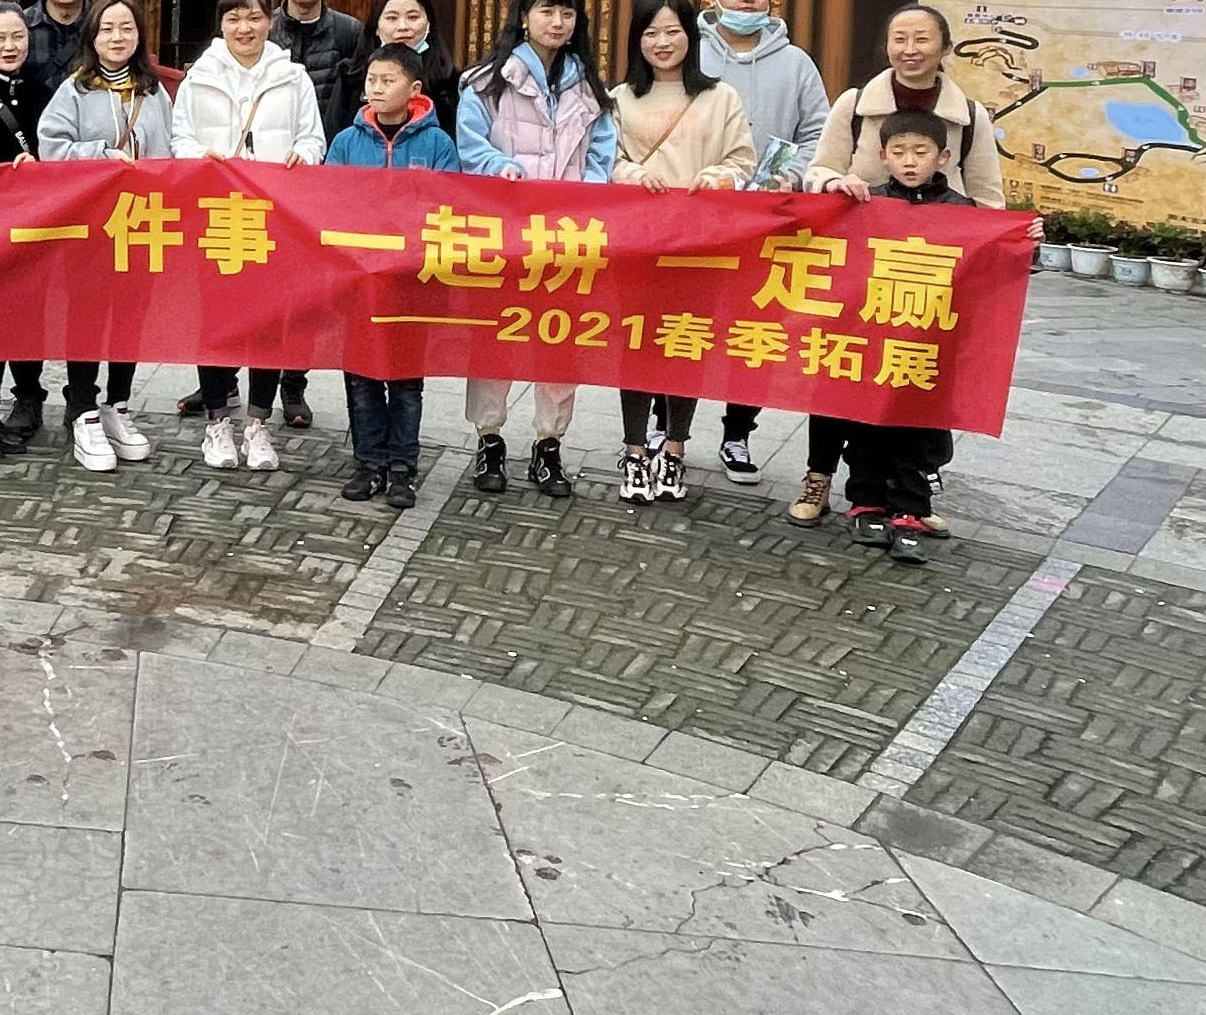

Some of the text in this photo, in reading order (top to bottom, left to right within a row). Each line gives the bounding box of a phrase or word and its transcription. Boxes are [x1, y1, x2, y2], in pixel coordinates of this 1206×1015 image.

[10, 191, 277, 275] 一件事
[320, 205, 609, 294] 一起拼
[656, 230, 964, 333] 一定赢
